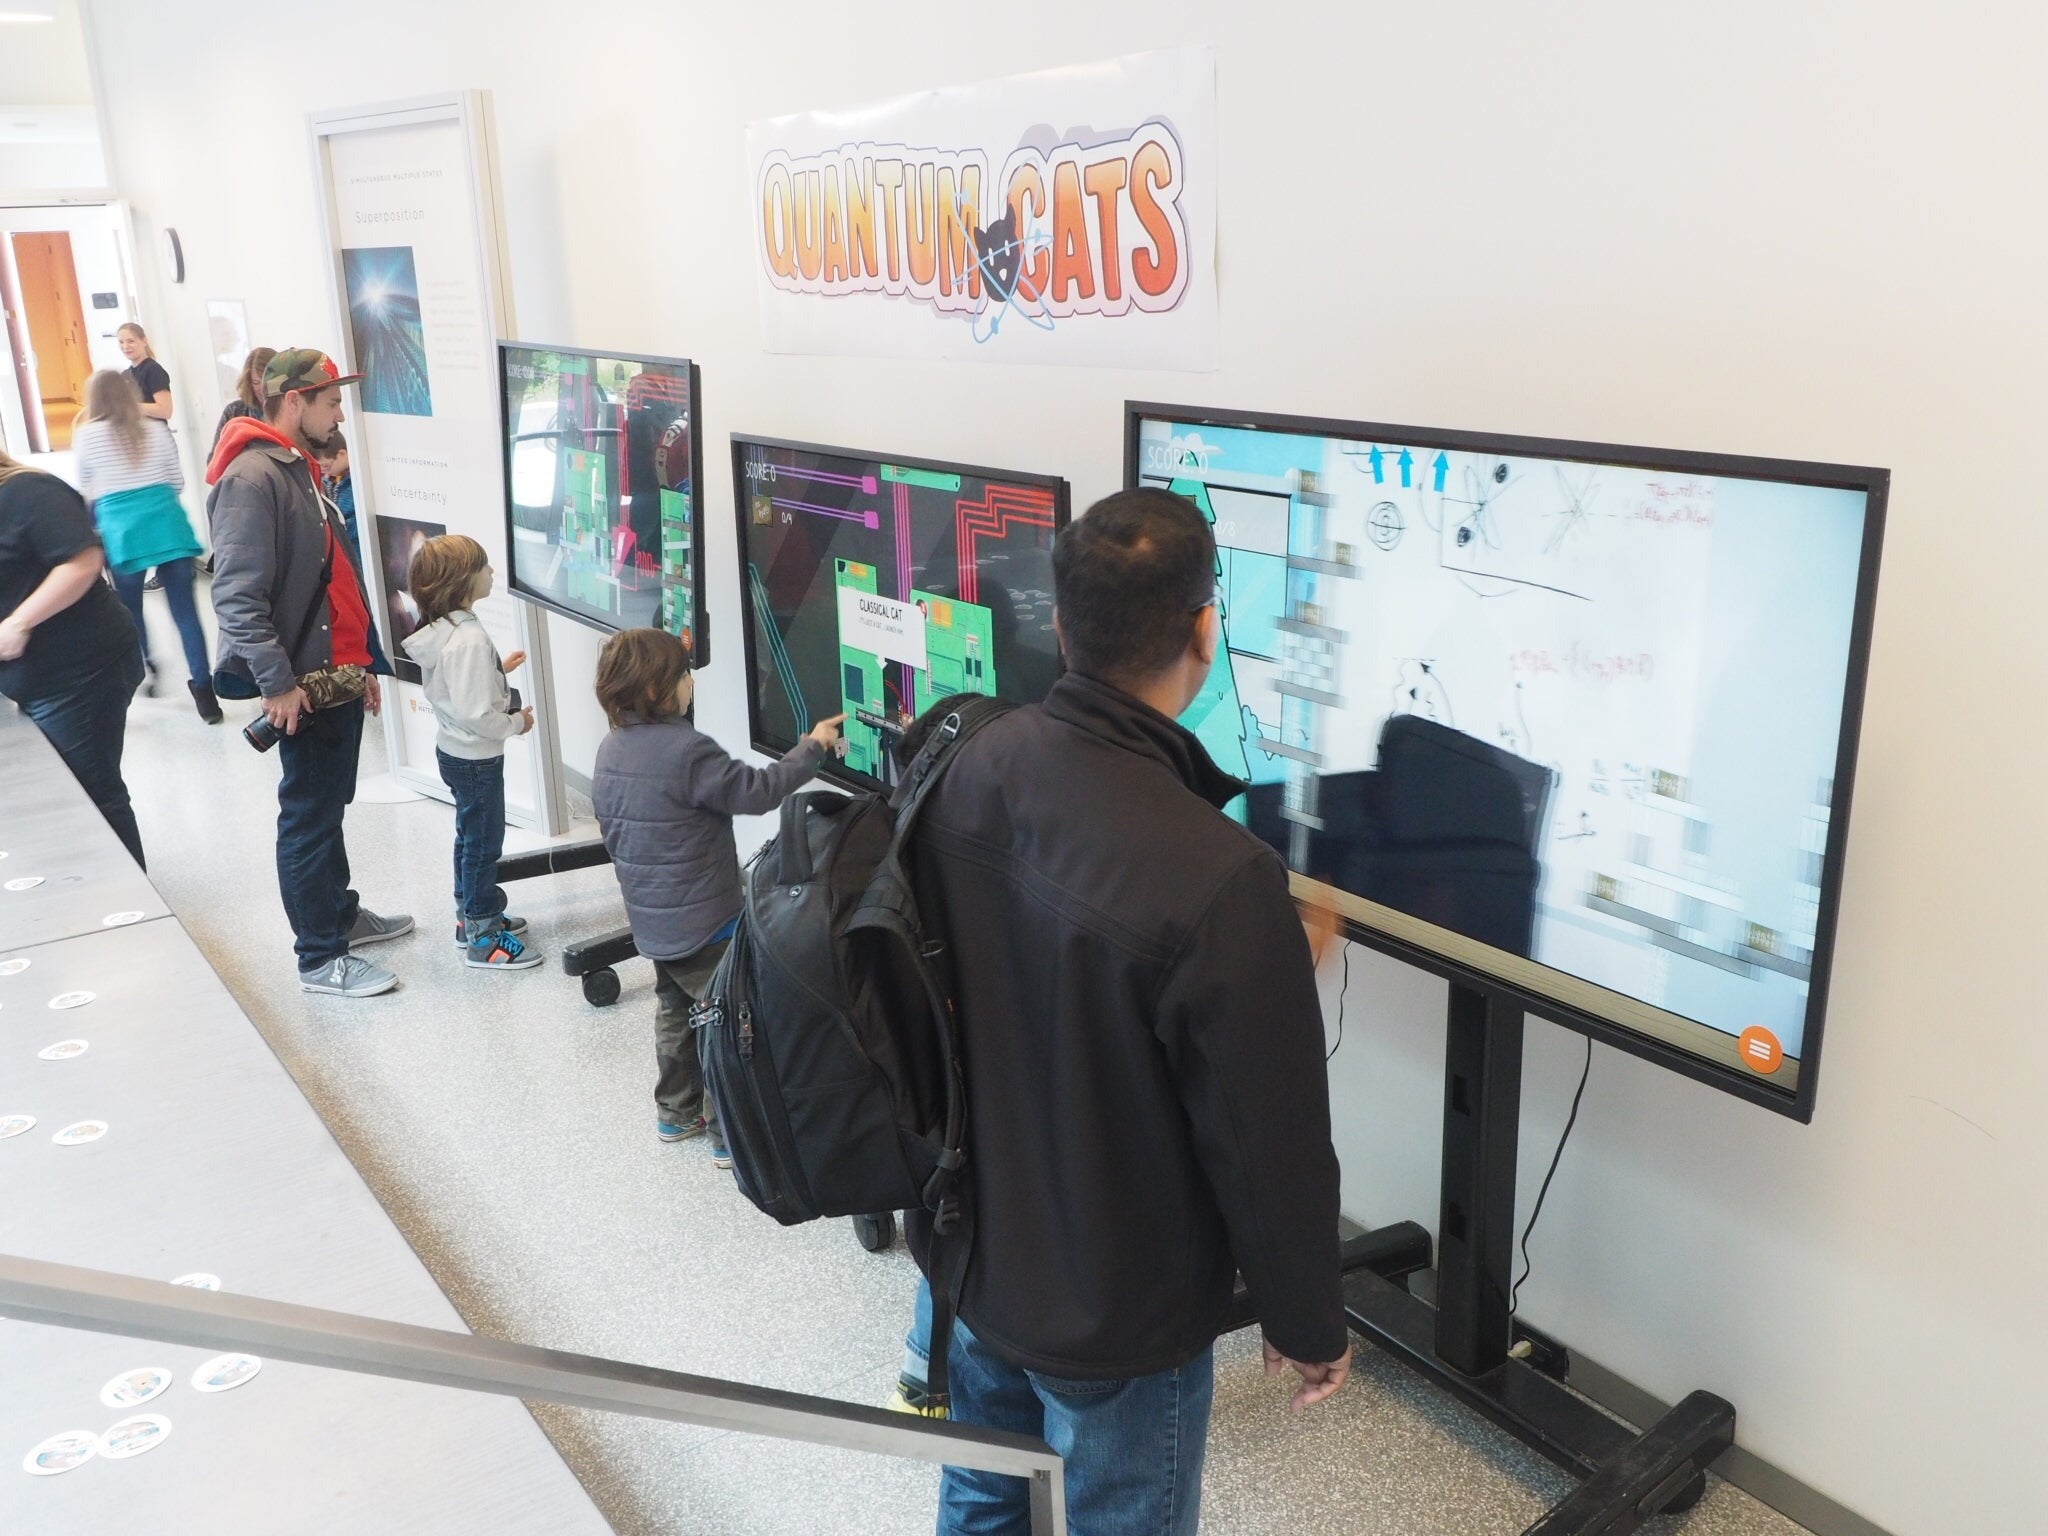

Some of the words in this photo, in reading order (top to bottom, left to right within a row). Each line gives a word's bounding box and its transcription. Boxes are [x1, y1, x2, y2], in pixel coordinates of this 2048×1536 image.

[355, 209, 425, 224] Superposition
[763, 156, 981, 300] QUANTUM
[1006, 139, 1178, 302] CATS
[386, 456, 408, 464] LIMITED
[410, 458, 448, 468] INFORMATION
[390, 485, 447, 505] Uncertainty
[859, 598, 890, 618] CLASSICAL
[890, 607, 902, 622] CAT
